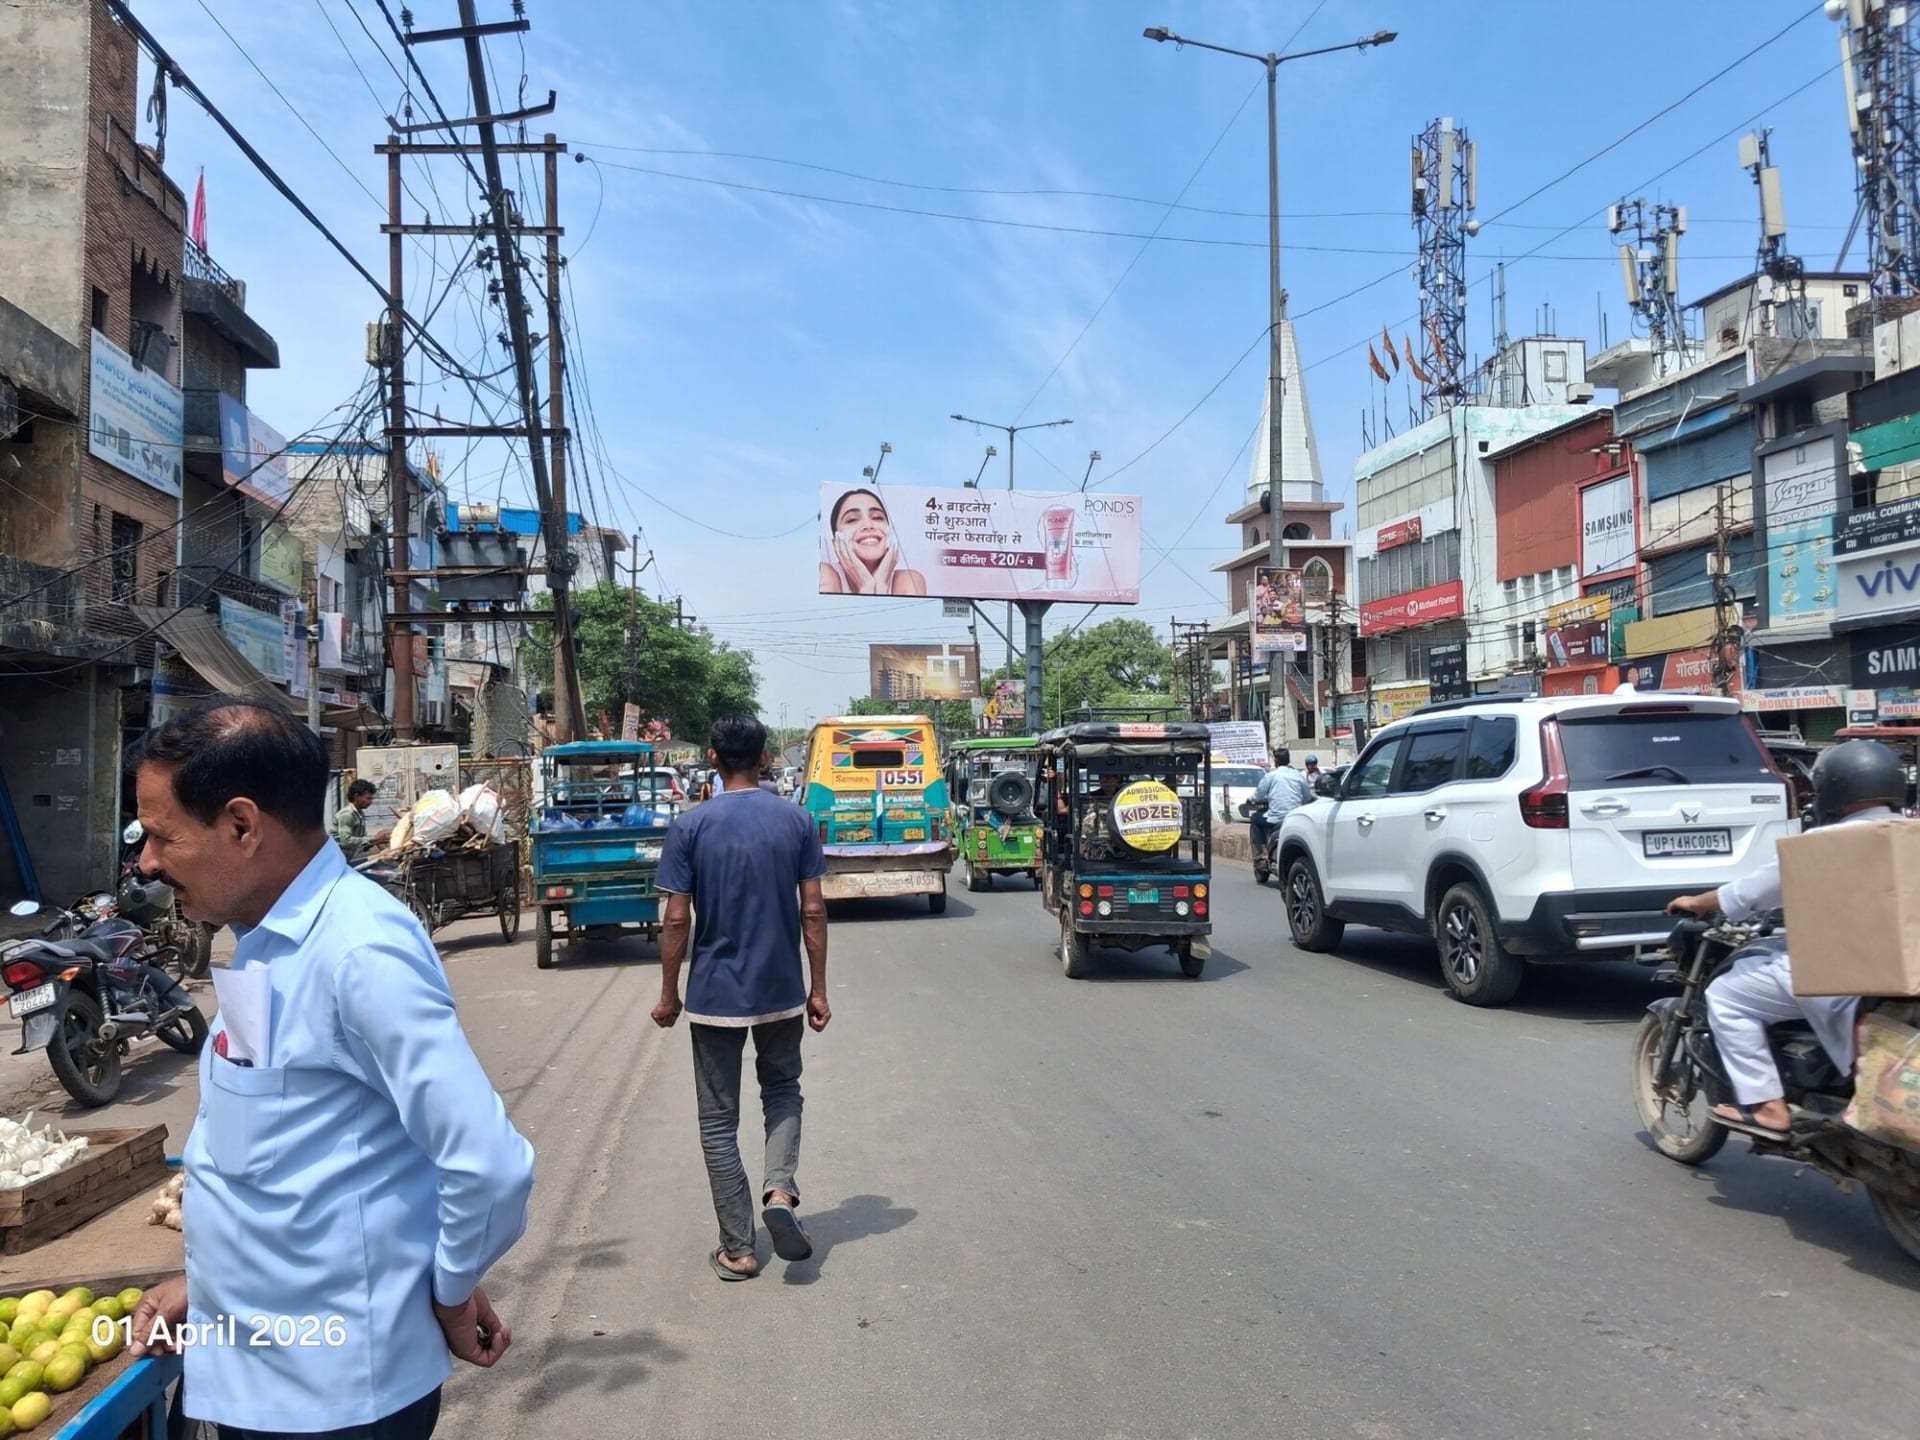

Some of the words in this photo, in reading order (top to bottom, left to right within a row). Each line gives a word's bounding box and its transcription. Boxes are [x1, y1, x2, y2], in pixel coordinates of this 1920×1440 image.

[1084, 499, 1135, 514] POND'S
[925, 512, 940, 526] की
[944, 515, 987, 530] शुरुआत
[1585, 508, 1633, 536] SAMSUNG
[1848, 511, 1879, 525] ROYAL
[1011, 531, 1022, 544] से
[1676, 658, 1699, 678] गोल्ड
[1868, 647, 1920, 675] SAM
[884, 771, 923, 785] 0551
[1139, 793, 1159, 802] OPEN
[1120, 804, 1179, 824] KIDZEE
[1654, 835, 1727, 850] UP14HC0051
